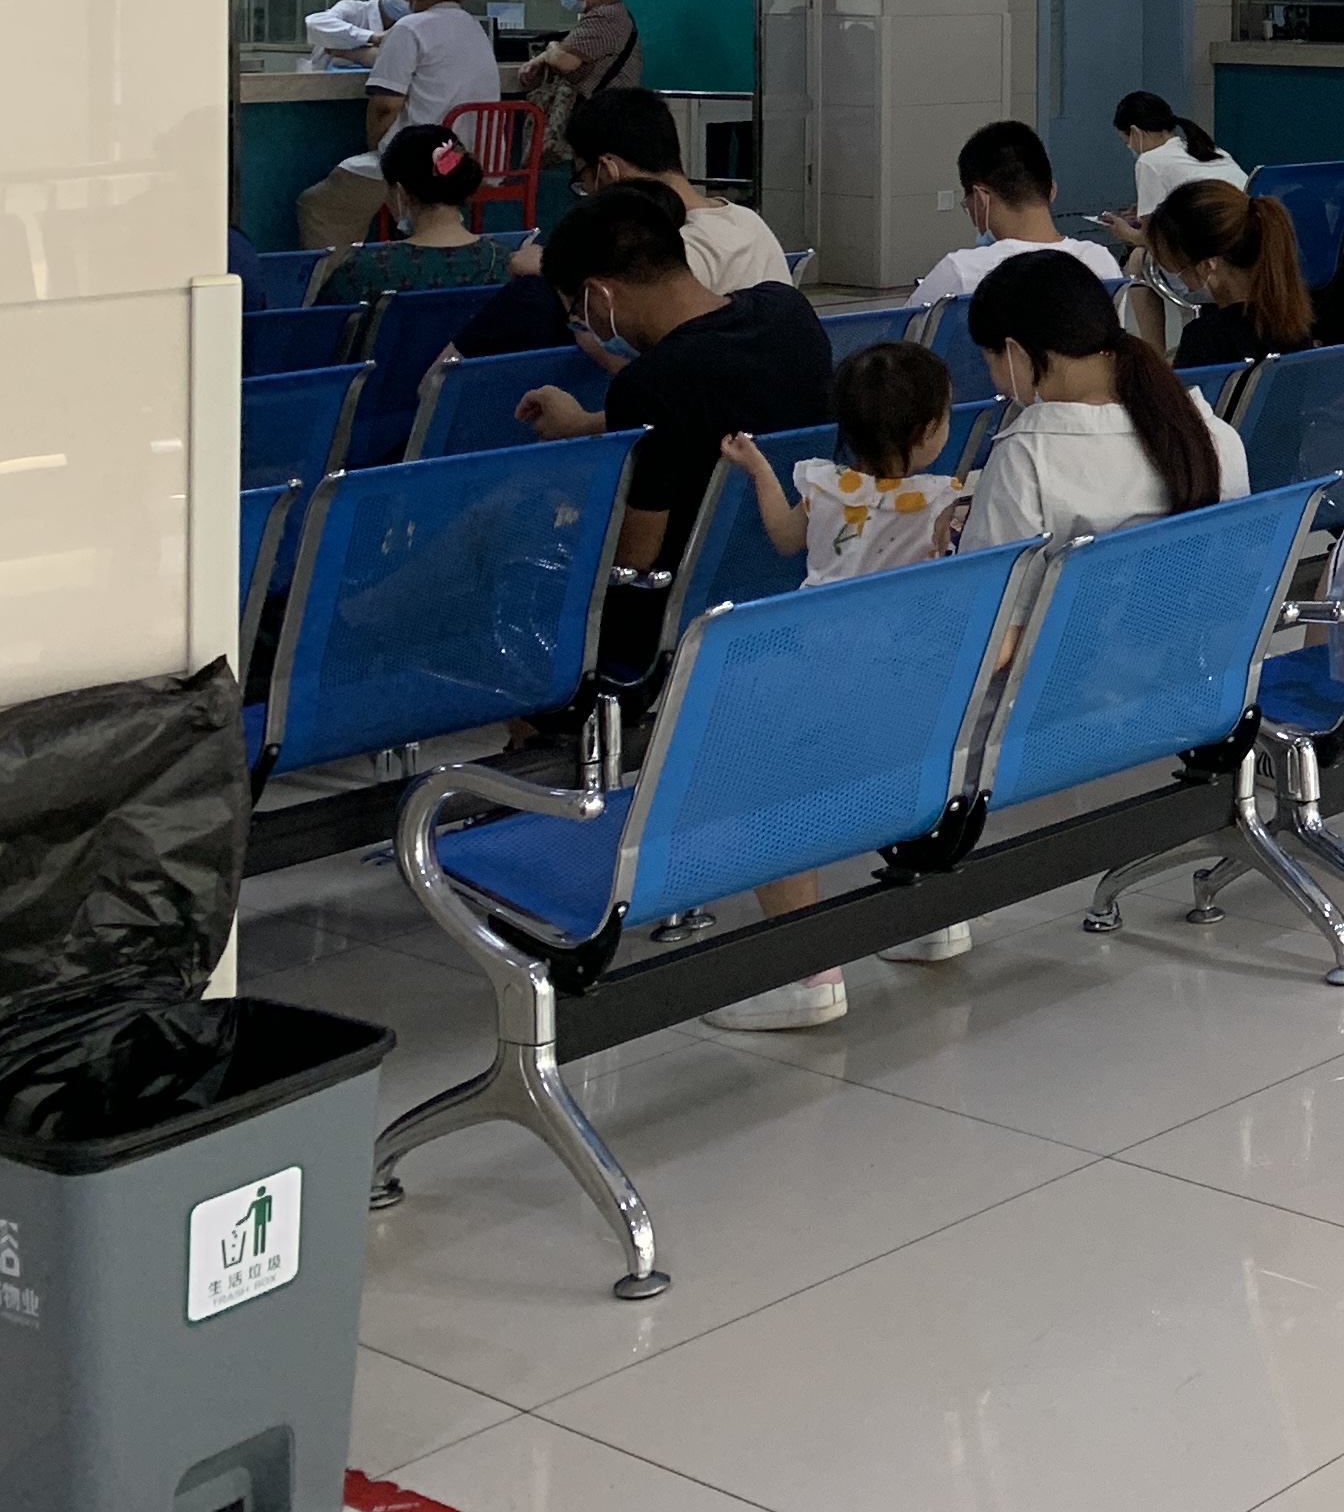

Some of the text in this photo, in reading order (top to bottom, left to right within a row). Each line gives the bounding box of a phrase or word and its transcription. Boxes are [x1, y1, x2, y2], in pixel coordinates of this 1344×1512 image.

[208, 1254, 281, 1298] 生活垃圾
[0, 1282, 39, 1317] 物业
